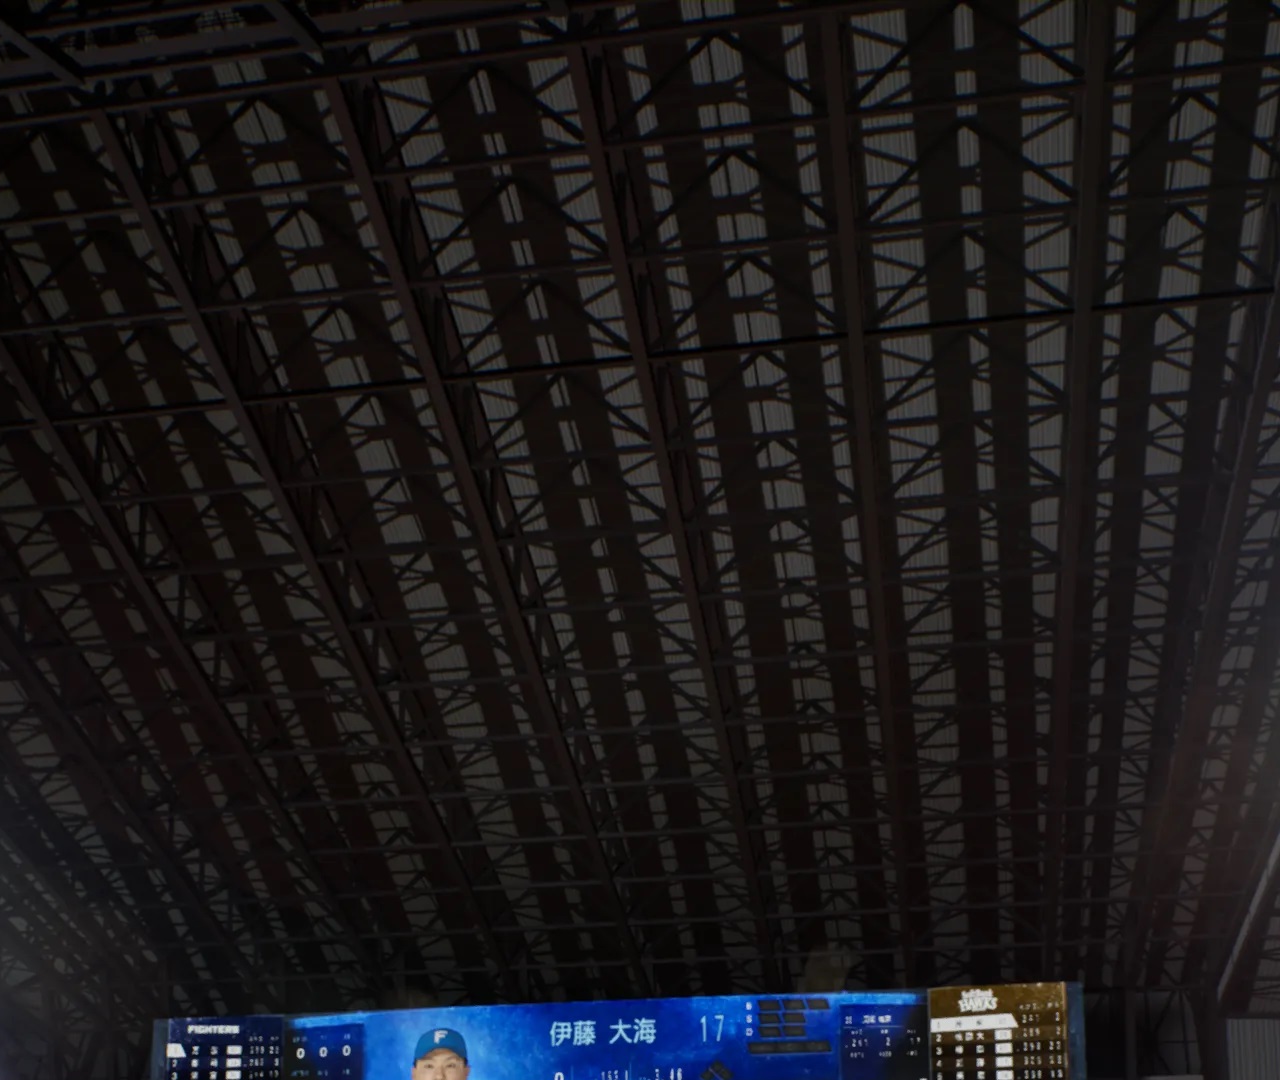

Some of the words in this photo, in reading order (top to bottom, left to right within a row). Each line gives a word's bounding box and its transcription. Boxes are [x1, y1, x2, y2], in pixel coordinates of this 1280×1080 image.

[958, 997, 998, 1012] HAWKS
[187, 1025, 240, 1034] FIGHTERS
[550, 1020, 597, 1047] 伊藤
[609, 1017, 657, 1045] 大海
[700, 1014, 725, 1042] 17
[434, 1030, 448, 1044] F
[296, 1048, 305, 1059] 0
[319, 1046, 328, 1058] 0
[342, 1045, 351, 1056] 0
